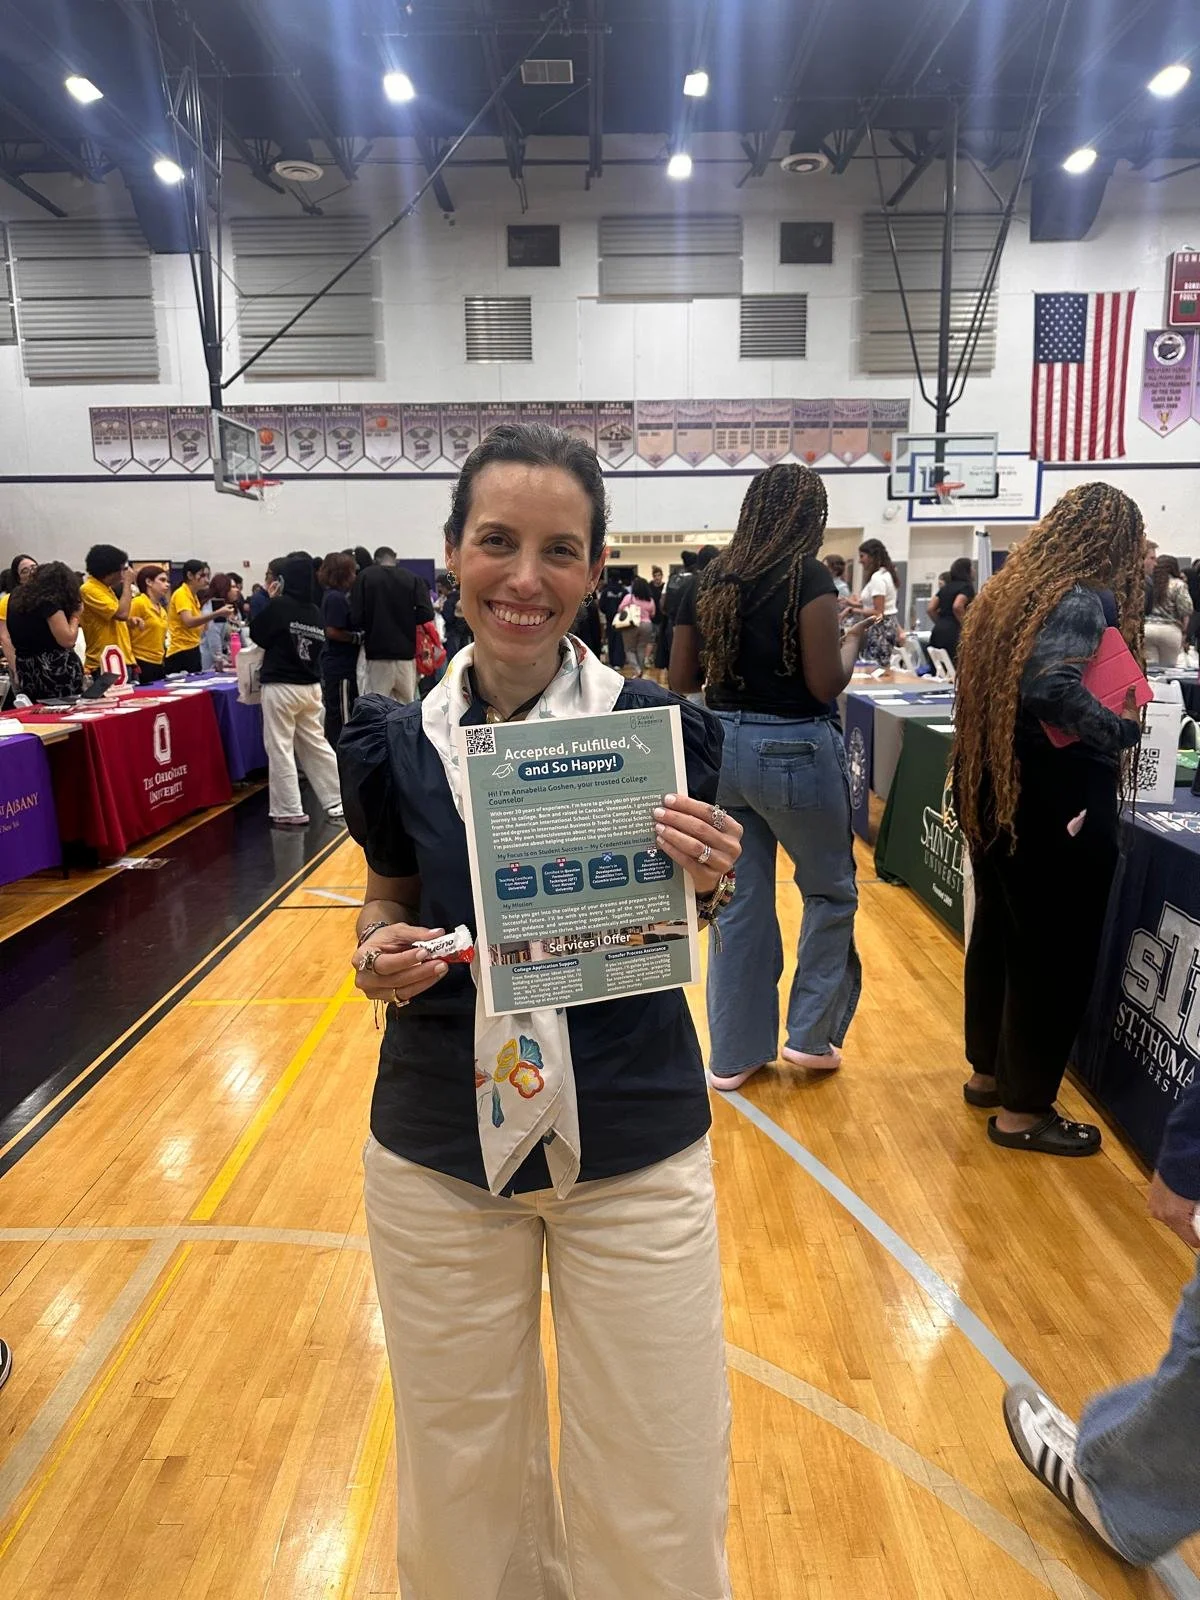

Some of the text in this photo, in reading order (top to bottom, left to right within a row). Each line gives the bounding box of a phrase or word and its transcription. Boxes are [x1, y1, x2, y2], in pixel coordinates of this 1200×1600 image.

[1178, 254, 1200, 263] HOM
[1184, 281, 1200, 290] BONU
[503, 736, 630, 760] Accepted, Fulfilled,
[524, 755, 616, 776] and So Happy!
[511, 786, 546, 795] Annabella
[548, 782, 576, 790] Goshen,
[577, 781, 592, 789] your
[594, 778, 619, 786] trusted
[621, 774, 647, 784] College
[6, 792, 38, 819] ALBANY
[488, 796, 524, 805] Counselor
[535, 830, 571, 838] indecisiveness
[537, 824, 568, 832] International
[921, 806, 953, 864] SAINT
[502, 841, 529, 850] passionate
[599, 839, 630, 847] Credentials
[925, 849, 961, 893] UNIVERSI
[548, 937, 594, 952] Services
[603, 932, 630, 945] Offer
[1113, 1027, 1181, 1100] UNIVERSI
